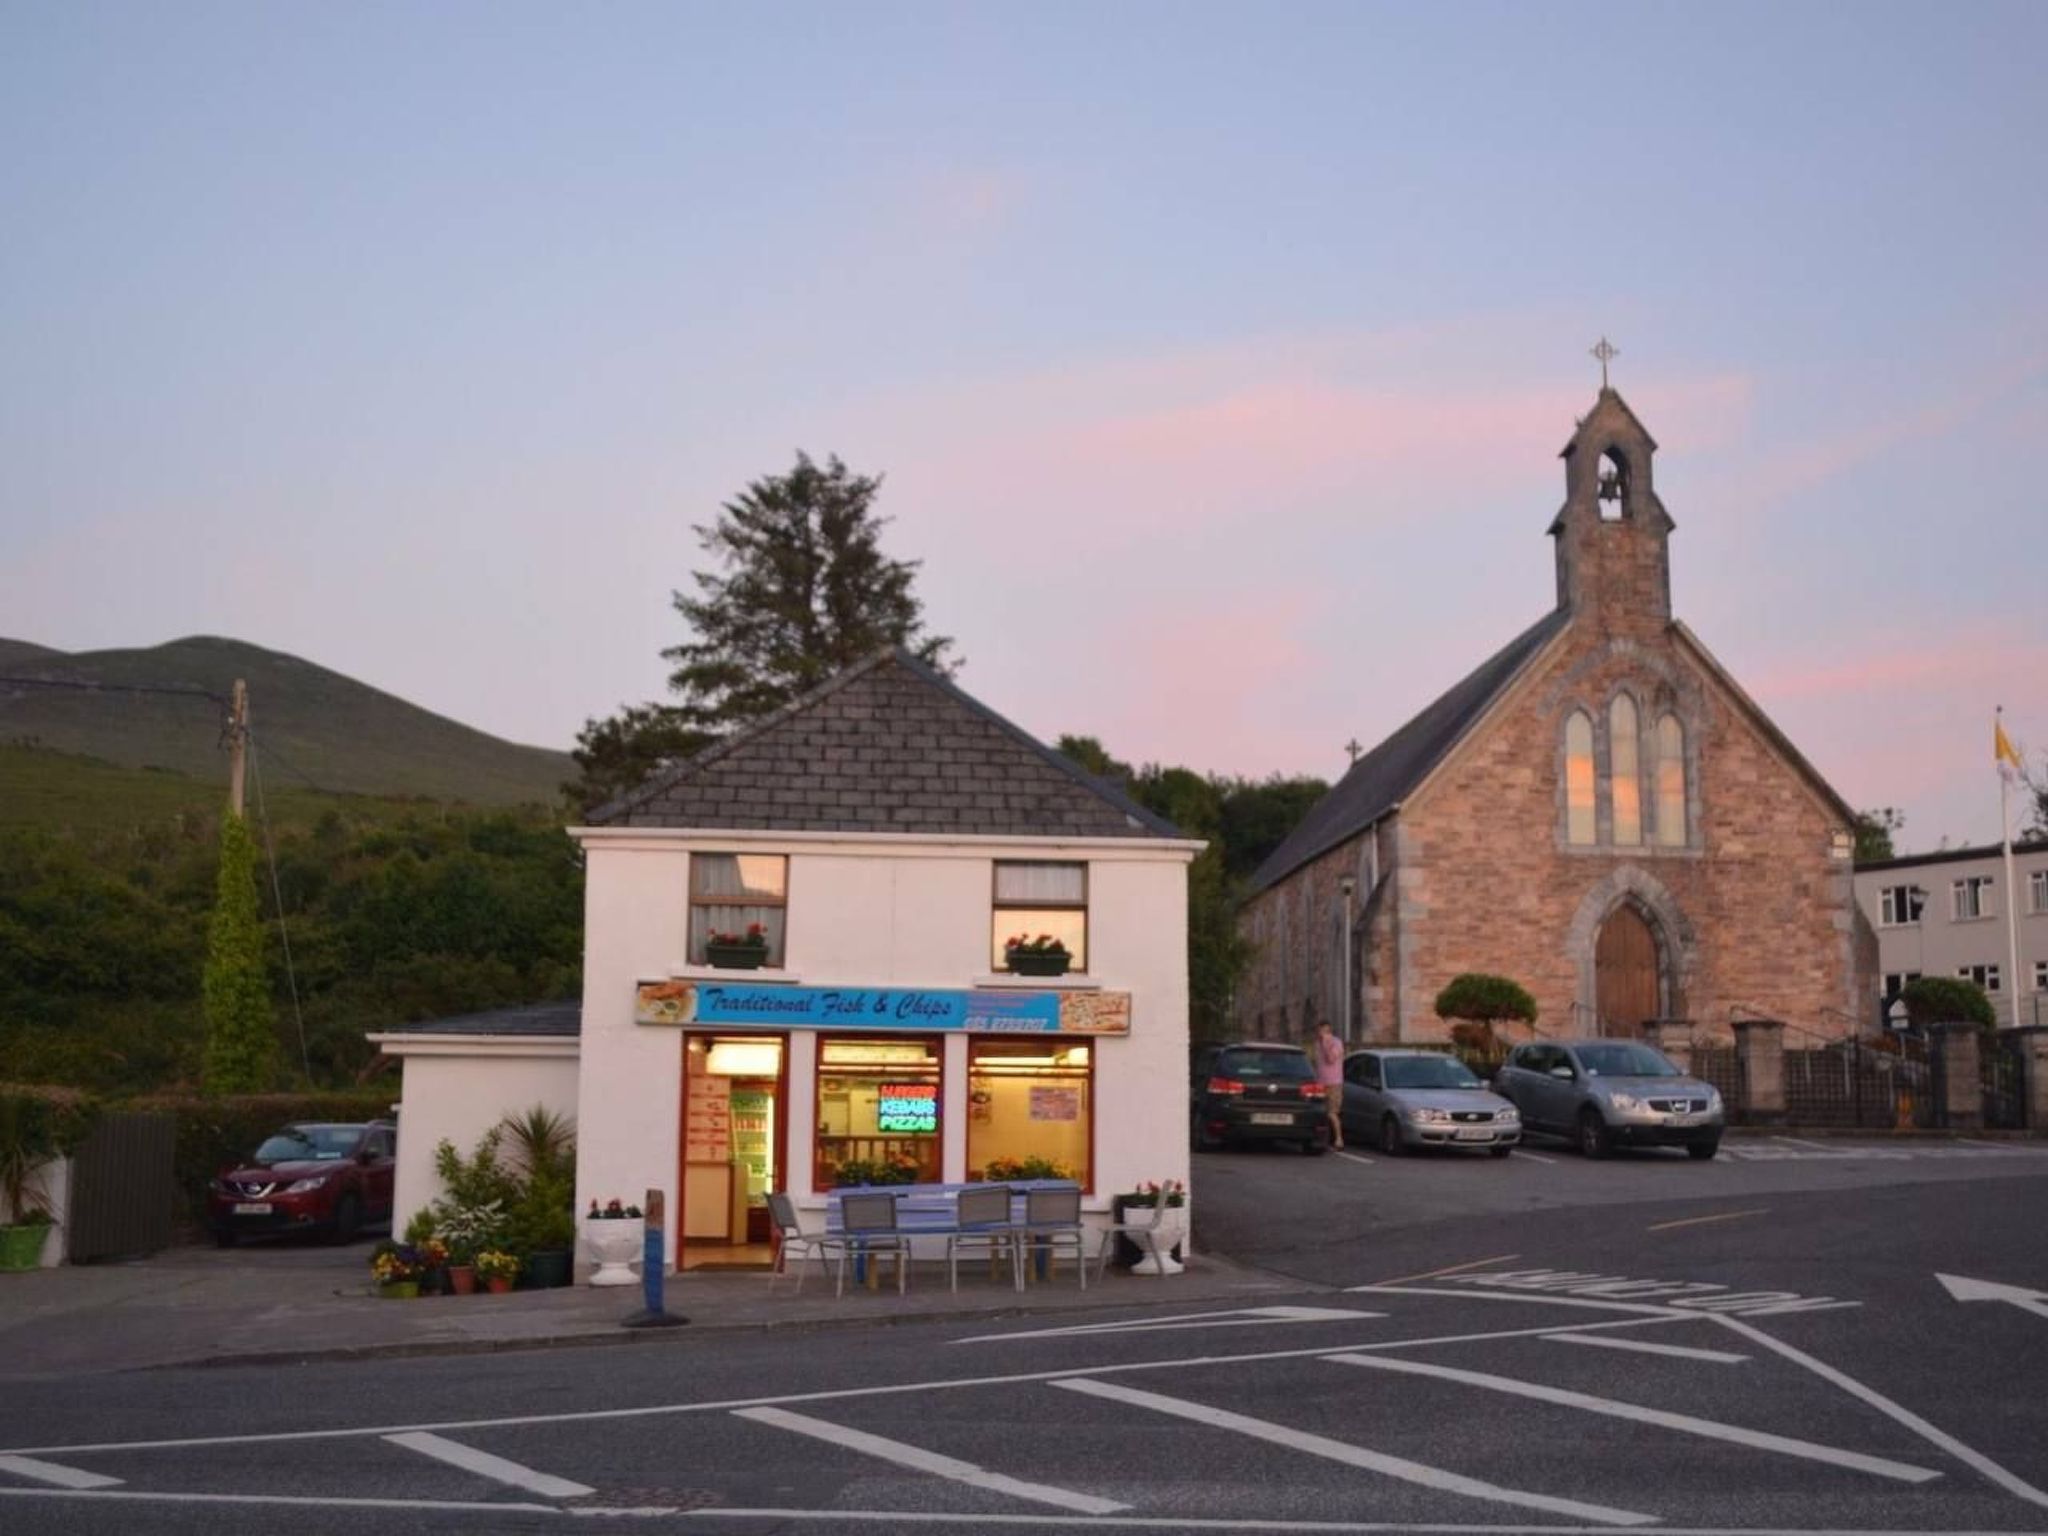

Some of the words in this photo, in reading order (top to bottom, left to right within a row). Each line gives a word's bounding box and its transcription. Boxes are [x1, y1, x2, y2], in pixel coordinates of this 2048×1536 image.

[705, 988, 815, 1012] Traditional
[821, 993, 867, 1017] Fish
[873, 992, 889, 1014] &
[895, 993, 953, 1020] Chips
[880, 1099, 936, 1115] KEBABS
[879, 1116, 937, 1131] PIZZAS
